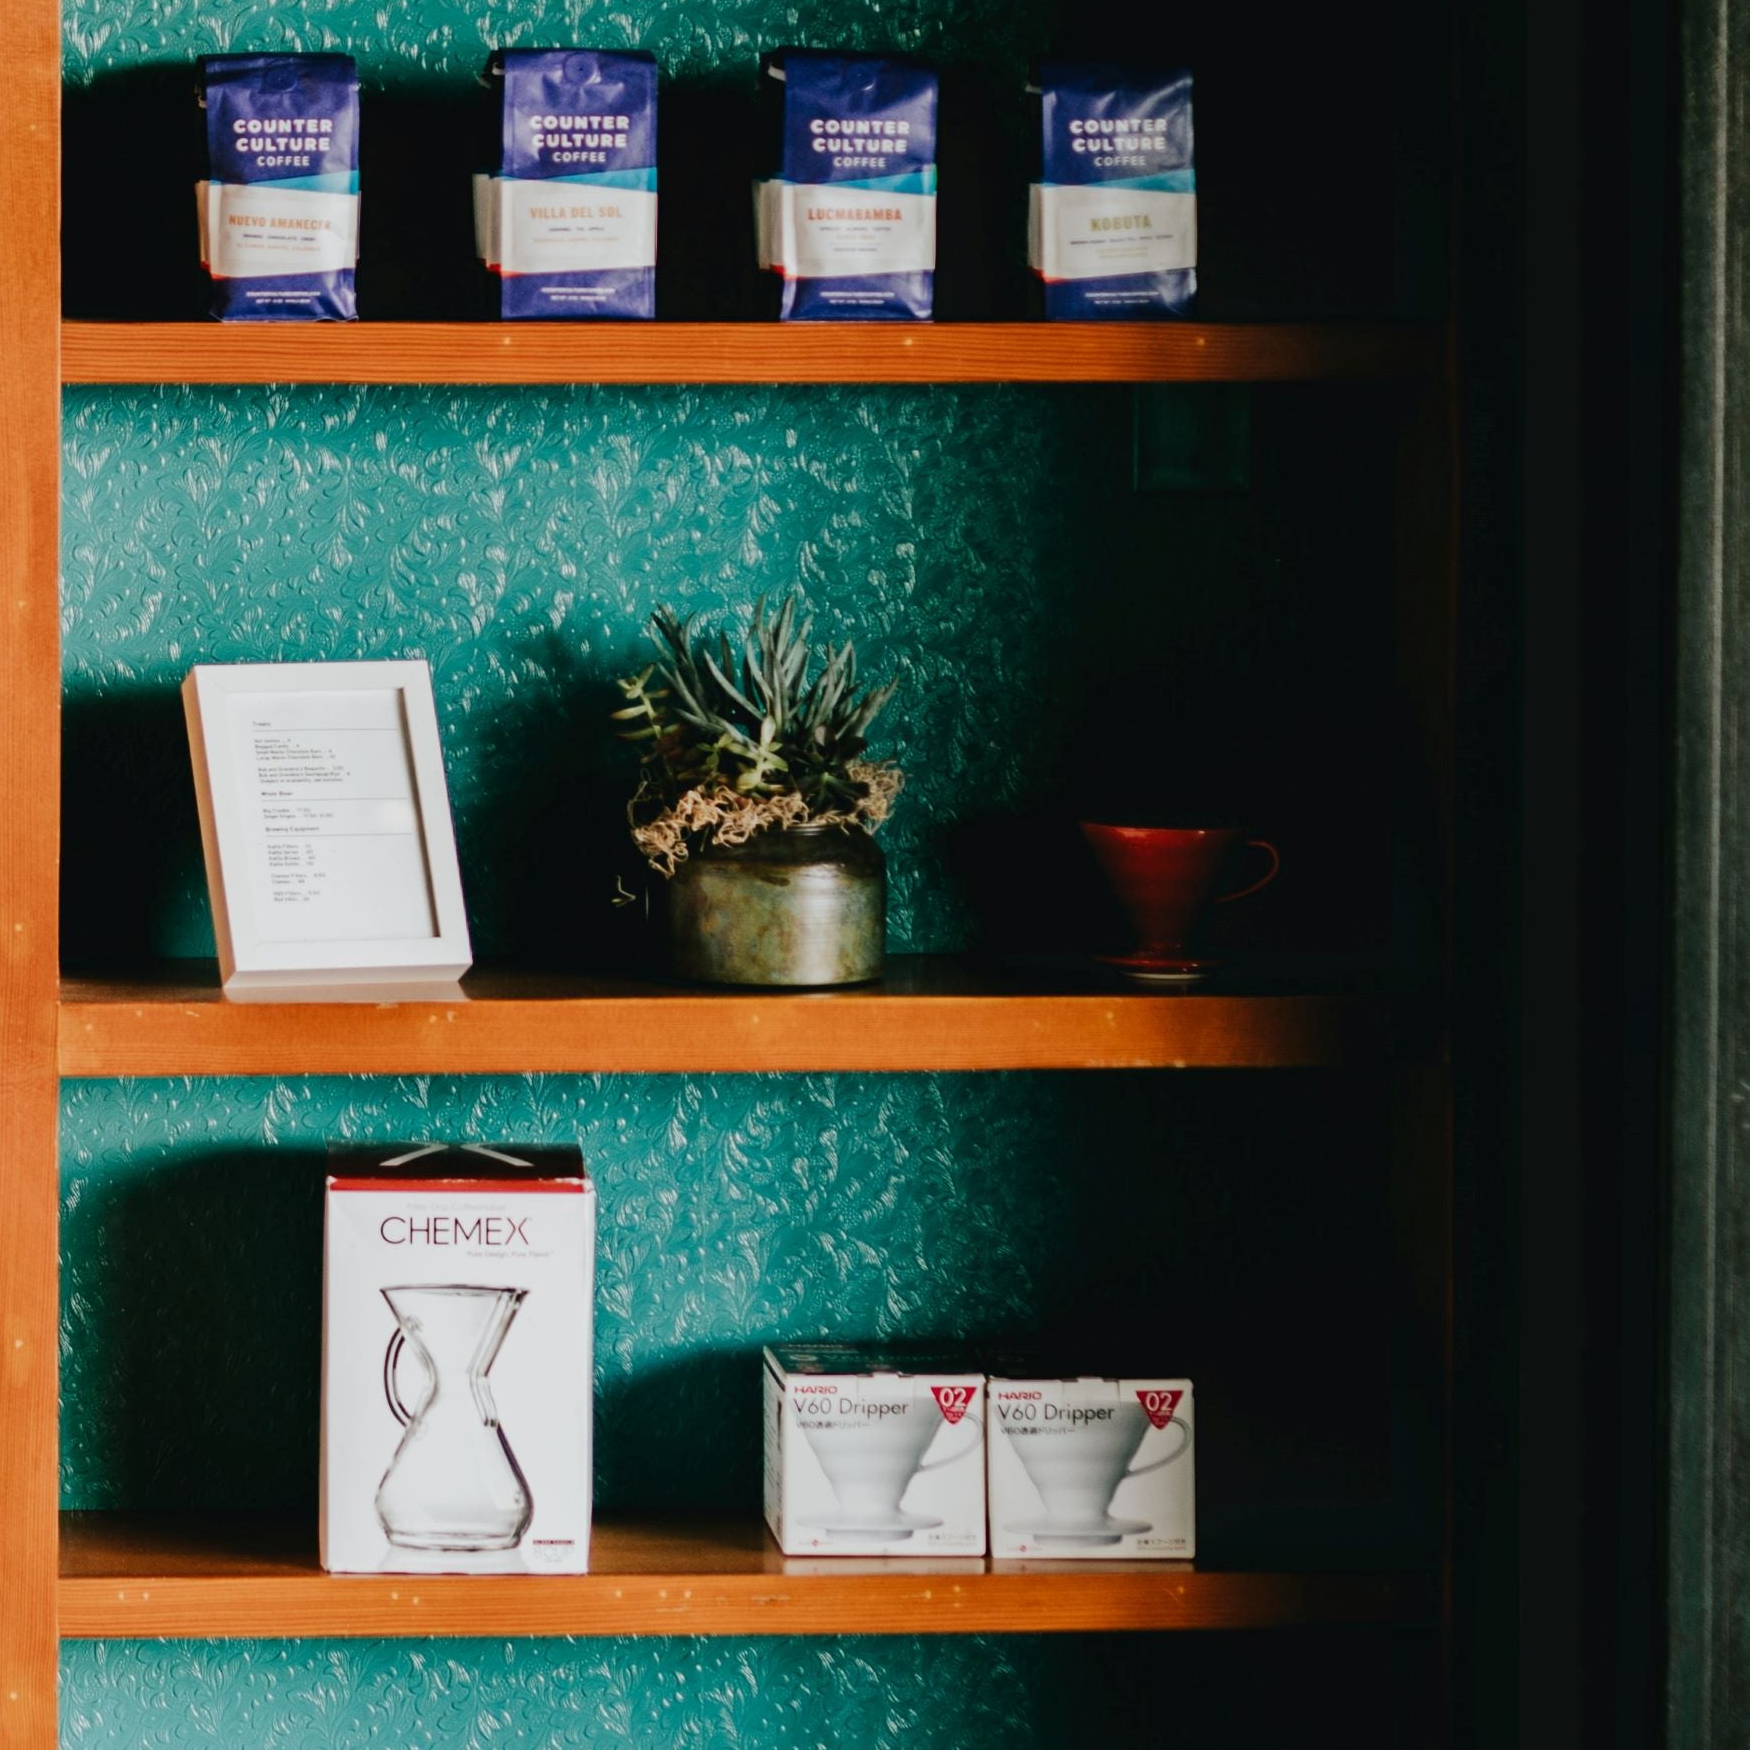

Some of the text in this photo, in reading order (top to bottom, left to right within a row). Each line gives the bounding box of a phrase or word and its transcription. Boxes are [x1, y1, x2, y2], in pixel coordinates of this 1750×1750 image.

[233, 118, 333, 135] COUNTER
[529, 115, 630, 131] COUNTER
[810, 119, 910, 135] COUNTER
[1069, 119, 1167, 135] COUNTER
[235, 137, 331, 152] CULTURE
[532, 133, 627, 149] CULTURE
[812, 138, 908, 153] CULTURE
[1073, 137, 1166, 152] CULTURE
[257, 156, 310, 167] COFFEE
[553, 152, 606, 163] COFFEE
[833, 156, 886, 168] COFFEE
[1094, 155, 1147, 167] COFFEE
[530, 207, 623, 220] VILLA DEL SOL
[808, 208, 903, 222] LUCMABAMBA
[228, 214, 267, 229] NUEVO
[1091, 215, 1152, 232] KOBUTA
[380, 1216, 530, 1245] CHEMEX
[794, 1386, 838, 1394] HARIO
[998, 1392, 1042, 1400] HARIO
[939, 1388, 967, 1408] 02
[1145, 1392, 1173, 1412] 02
[794, 1397, 909, 1420] V60 Dripper
[998, 1403, 1115, 1426] V60 Dripper
